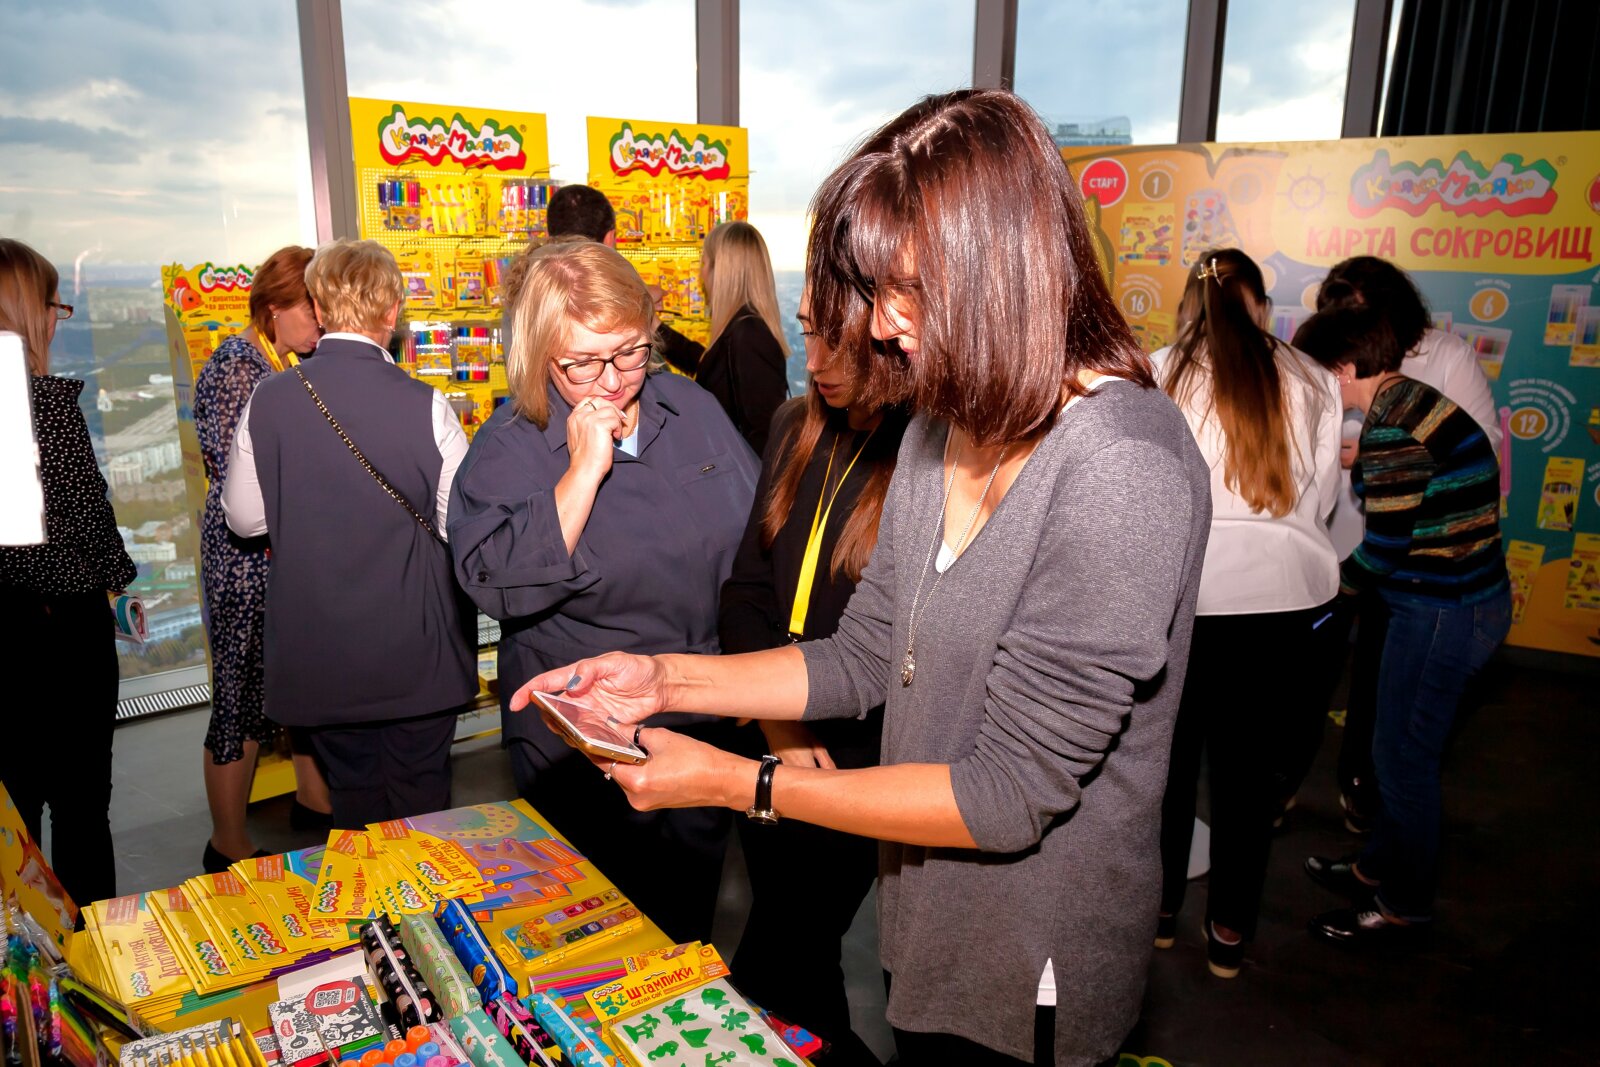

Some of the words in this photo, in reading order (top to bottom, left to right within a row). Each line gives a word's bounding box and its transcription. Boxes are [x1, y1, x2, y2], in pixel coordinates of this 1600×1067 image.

[1088, 177, 1119, 188] СТАРТ
[1152, 176, 1160, 195] 1
[1305, 226, 1397, 257] КАРТА
[1410, 226, 1593, 263] СОКРОВИЩ
[1130, 294, 1145, 313] 16
[1483, 296, 1494, 317] 6
[1519, 414, 1539, 434] 12
[286, 885, 334, 940] Аппкация
